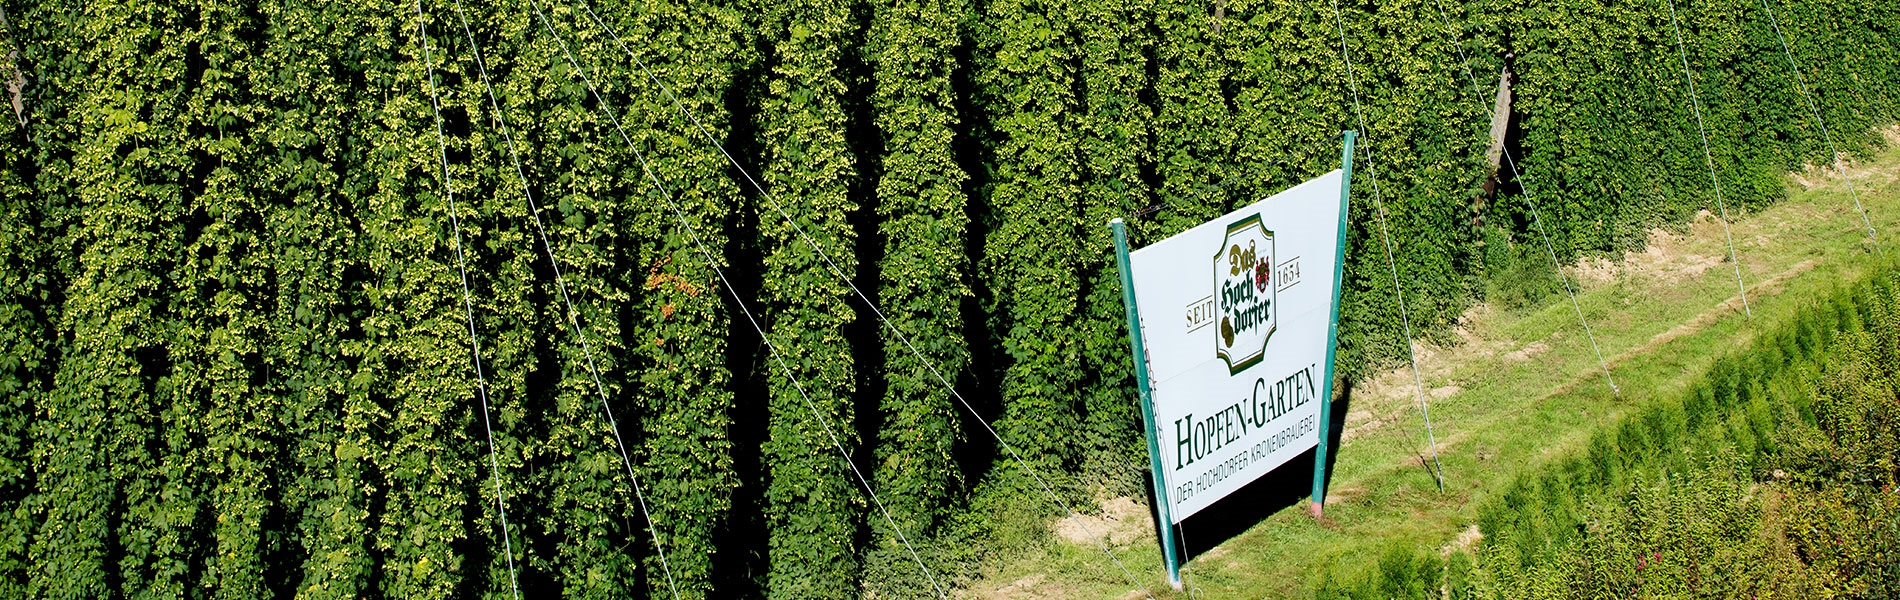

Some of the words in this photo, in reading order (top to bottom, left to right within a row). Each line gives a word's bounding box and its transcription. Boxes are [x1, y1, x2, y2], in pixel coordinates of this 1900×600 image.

[1229, 239, 1257, 277] Das
[1186, 300, 1213, 328] SEIT
[1277, 261, 1300, 288] 1654
[1221, 269, 1254, 314] Hoch
[1234, 296, 1271, 336] dorfer
[1175, 363, 1316, 471] HOPFEN-GARTEN
[1177, 481, 1194, 505] DER
[1196, 450, 1249, 494] HOCHDORFER
[1251, 413, 1316, 464] KRONENBRAUEREI
